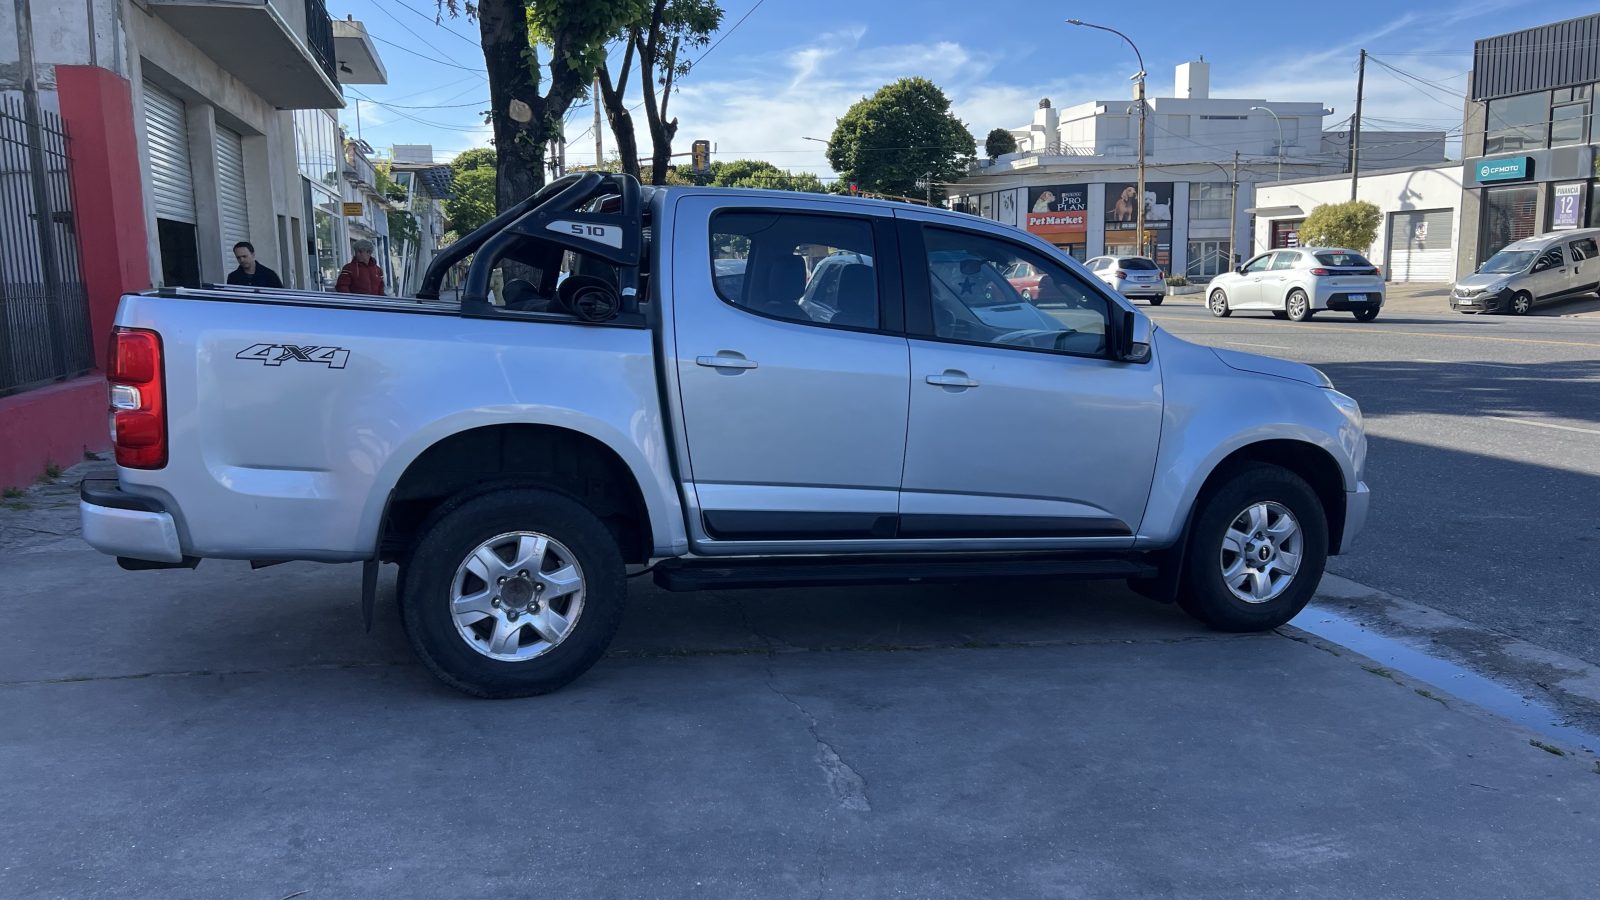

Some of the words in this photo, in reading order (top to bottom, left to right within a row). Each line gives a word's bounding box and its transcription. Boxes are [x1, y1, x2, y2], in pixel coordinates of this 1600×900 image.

[1490, 165, 1519, 173] CFMOTO
[1057, 203, 1086, 211] PLAN
[1560, 196, 1573, 213] 12
